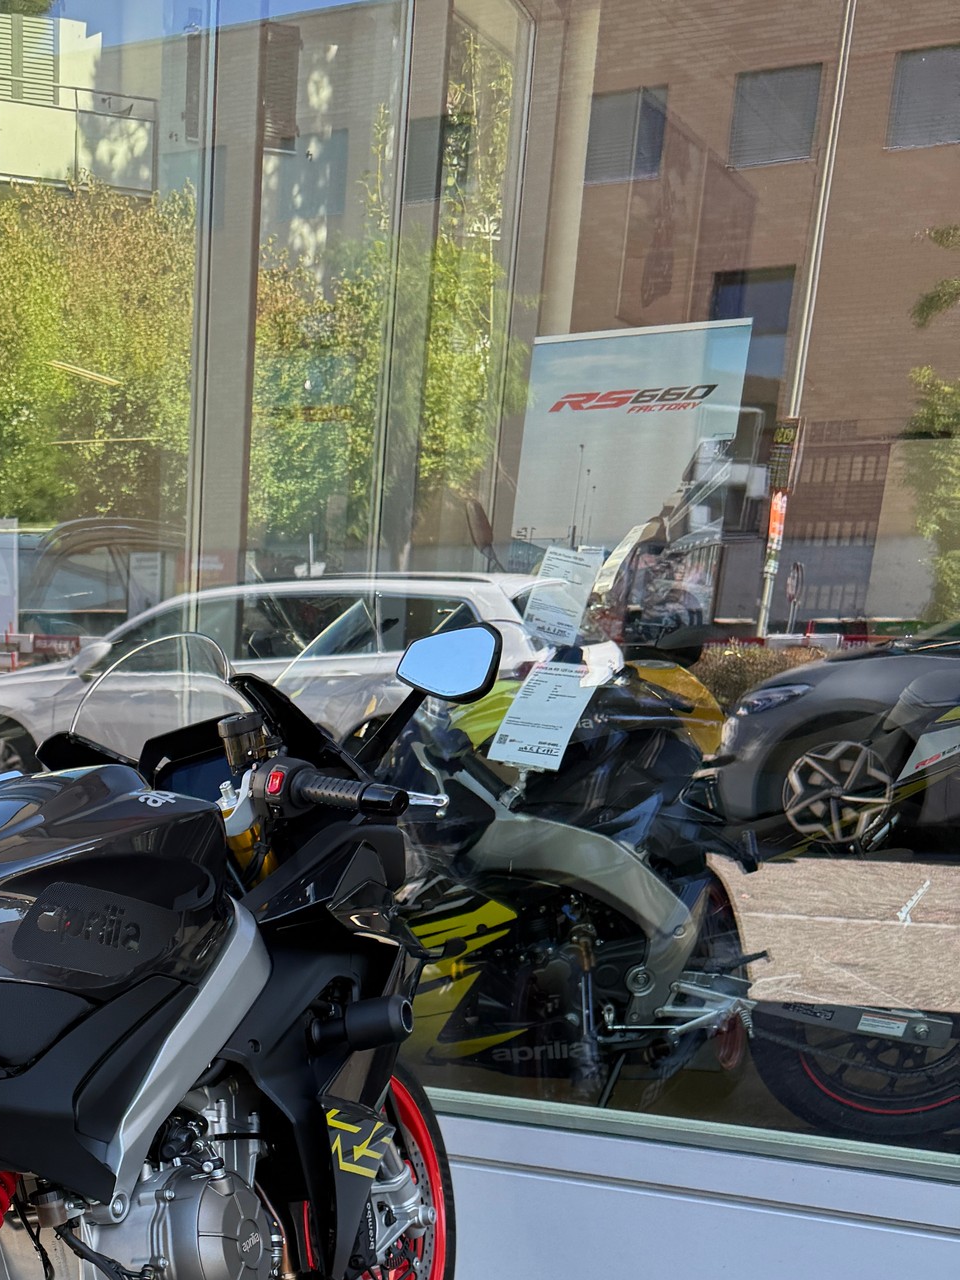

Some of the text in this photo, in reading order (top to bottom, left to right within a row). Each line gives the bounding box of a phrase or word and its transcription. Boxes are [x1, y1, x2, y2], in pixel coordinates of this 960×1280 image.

[548, 383, 719, 413] RS660
[626, 401, 702, 415] FACTORY
[491, 1040, 591, 1064] aprilia
[366, 1202, 375, 1250] brembo
